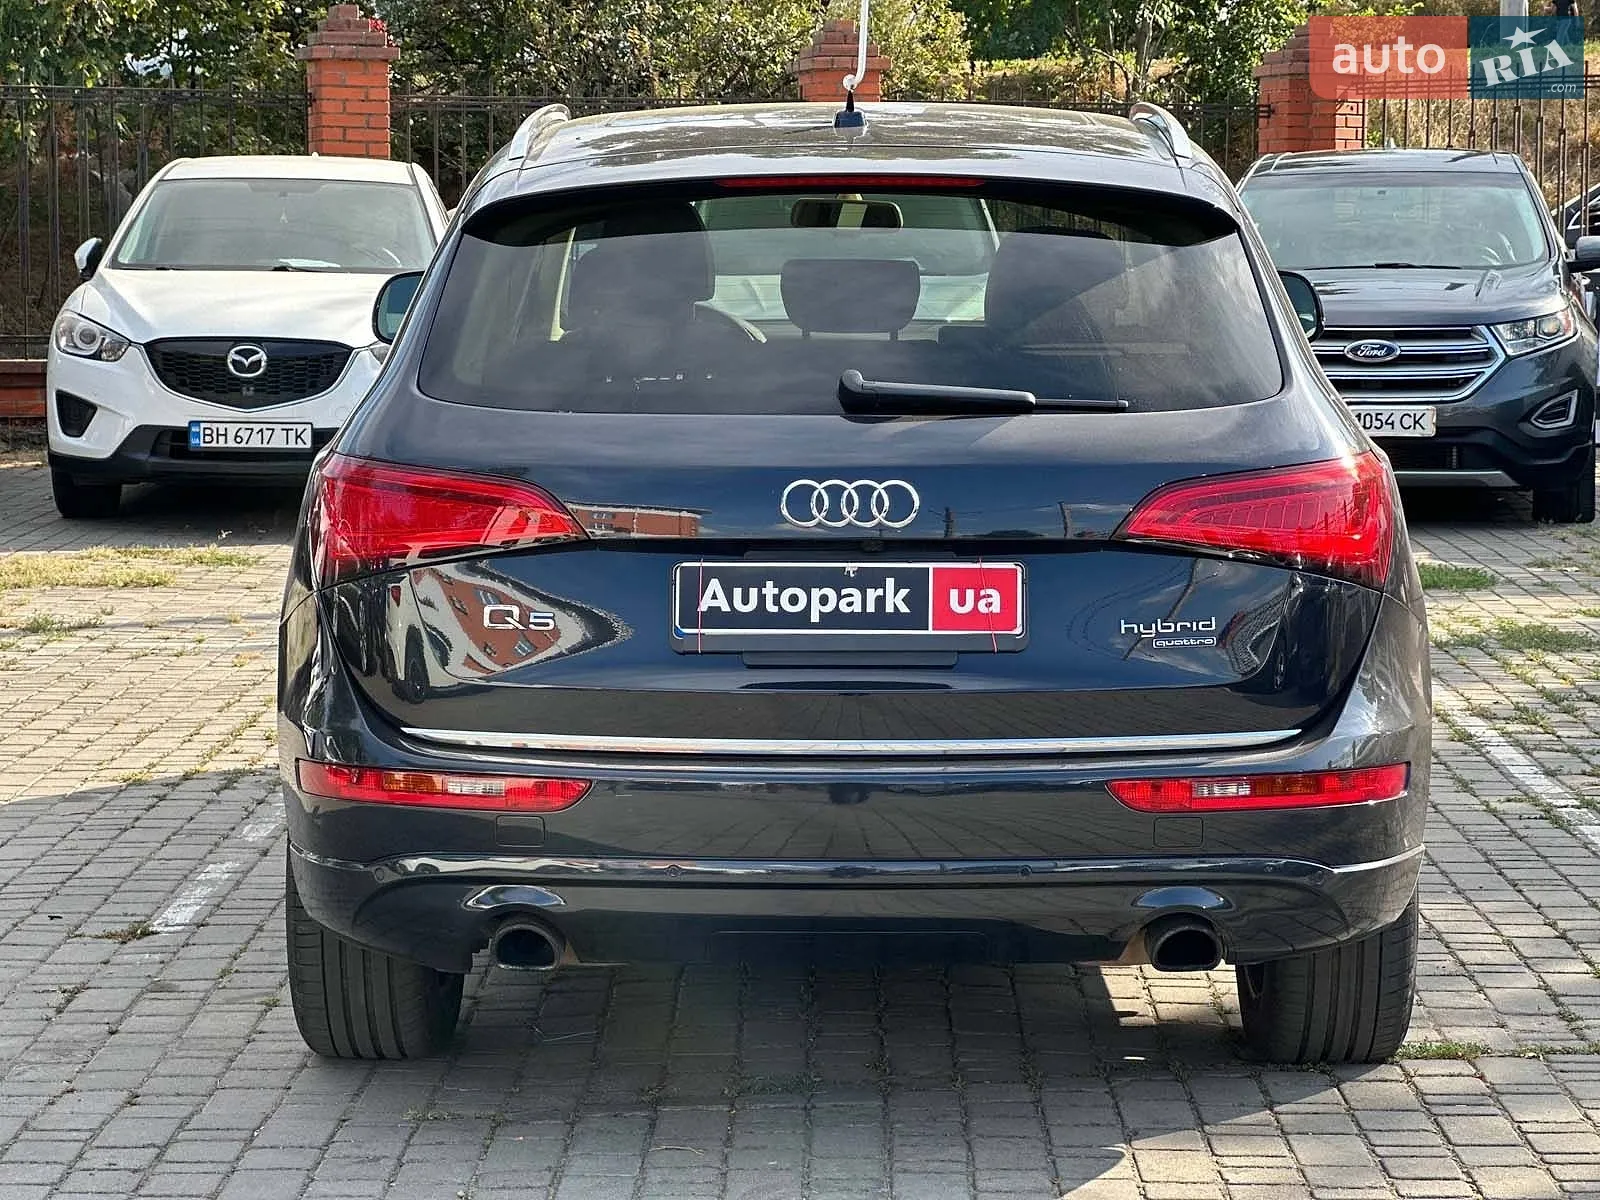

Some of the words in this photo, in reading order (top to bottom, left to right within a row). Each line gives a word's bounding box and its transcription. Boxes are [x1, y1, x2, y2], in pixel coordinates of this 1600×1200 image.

[1357, 344, 1388, 357] Ford
[1399, 412, 1427, 431] CK
[202, 427, 228, 445] BH
[233, 427, 276, 445] 6717
[280, 427, 308, 446] TK
[697, 577, 912, 624] Autopark
[949, 587, 1002, 615] ua
[483, 604, 555, 631] Q5
[1120, 616, 1216, 638] hybrid
[1155, 639, 1214, 647] quattro
